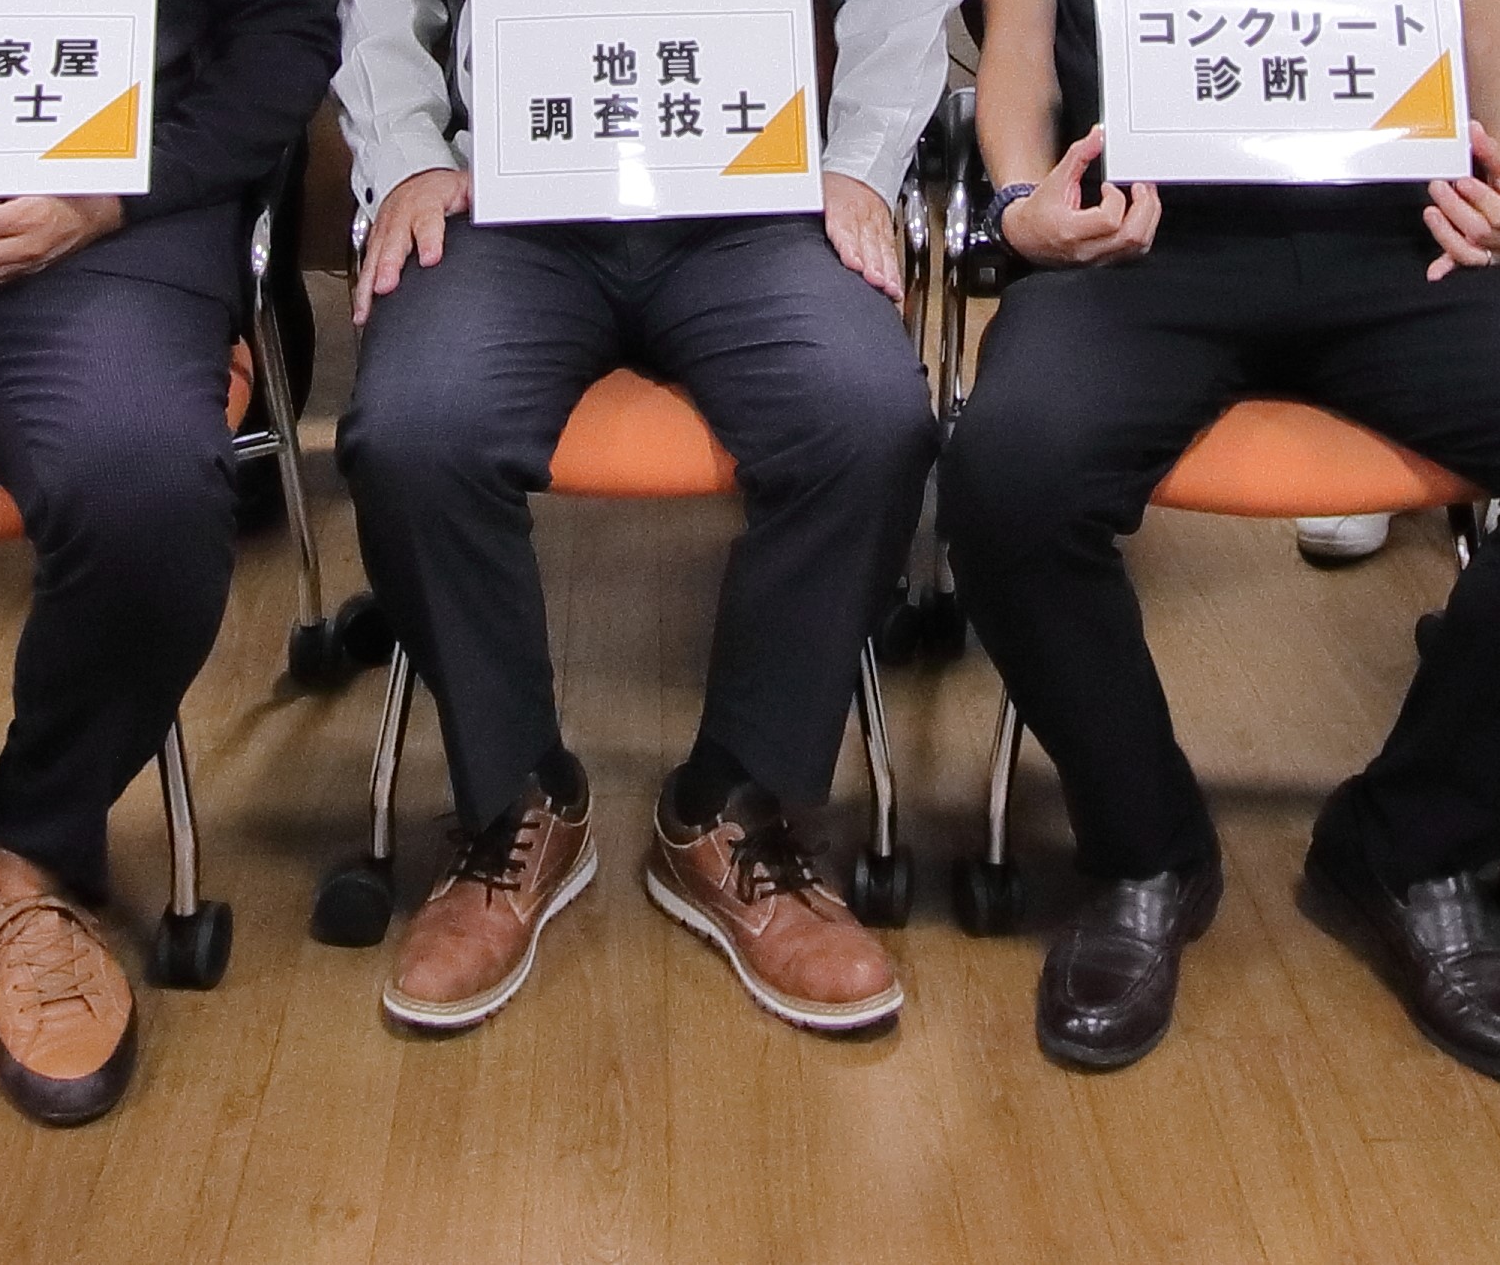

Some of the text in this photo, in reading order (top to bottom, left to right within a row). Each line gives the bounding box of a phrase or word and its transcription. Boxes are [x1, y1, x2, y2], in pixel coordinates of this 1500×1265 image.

[1138, 4, 1425, 48] コンクリート
[592, 40, 701, 86] 地質
[1193, 54, 1376, 102] 診断士
[529, 90, 767, 141] 調査技士
